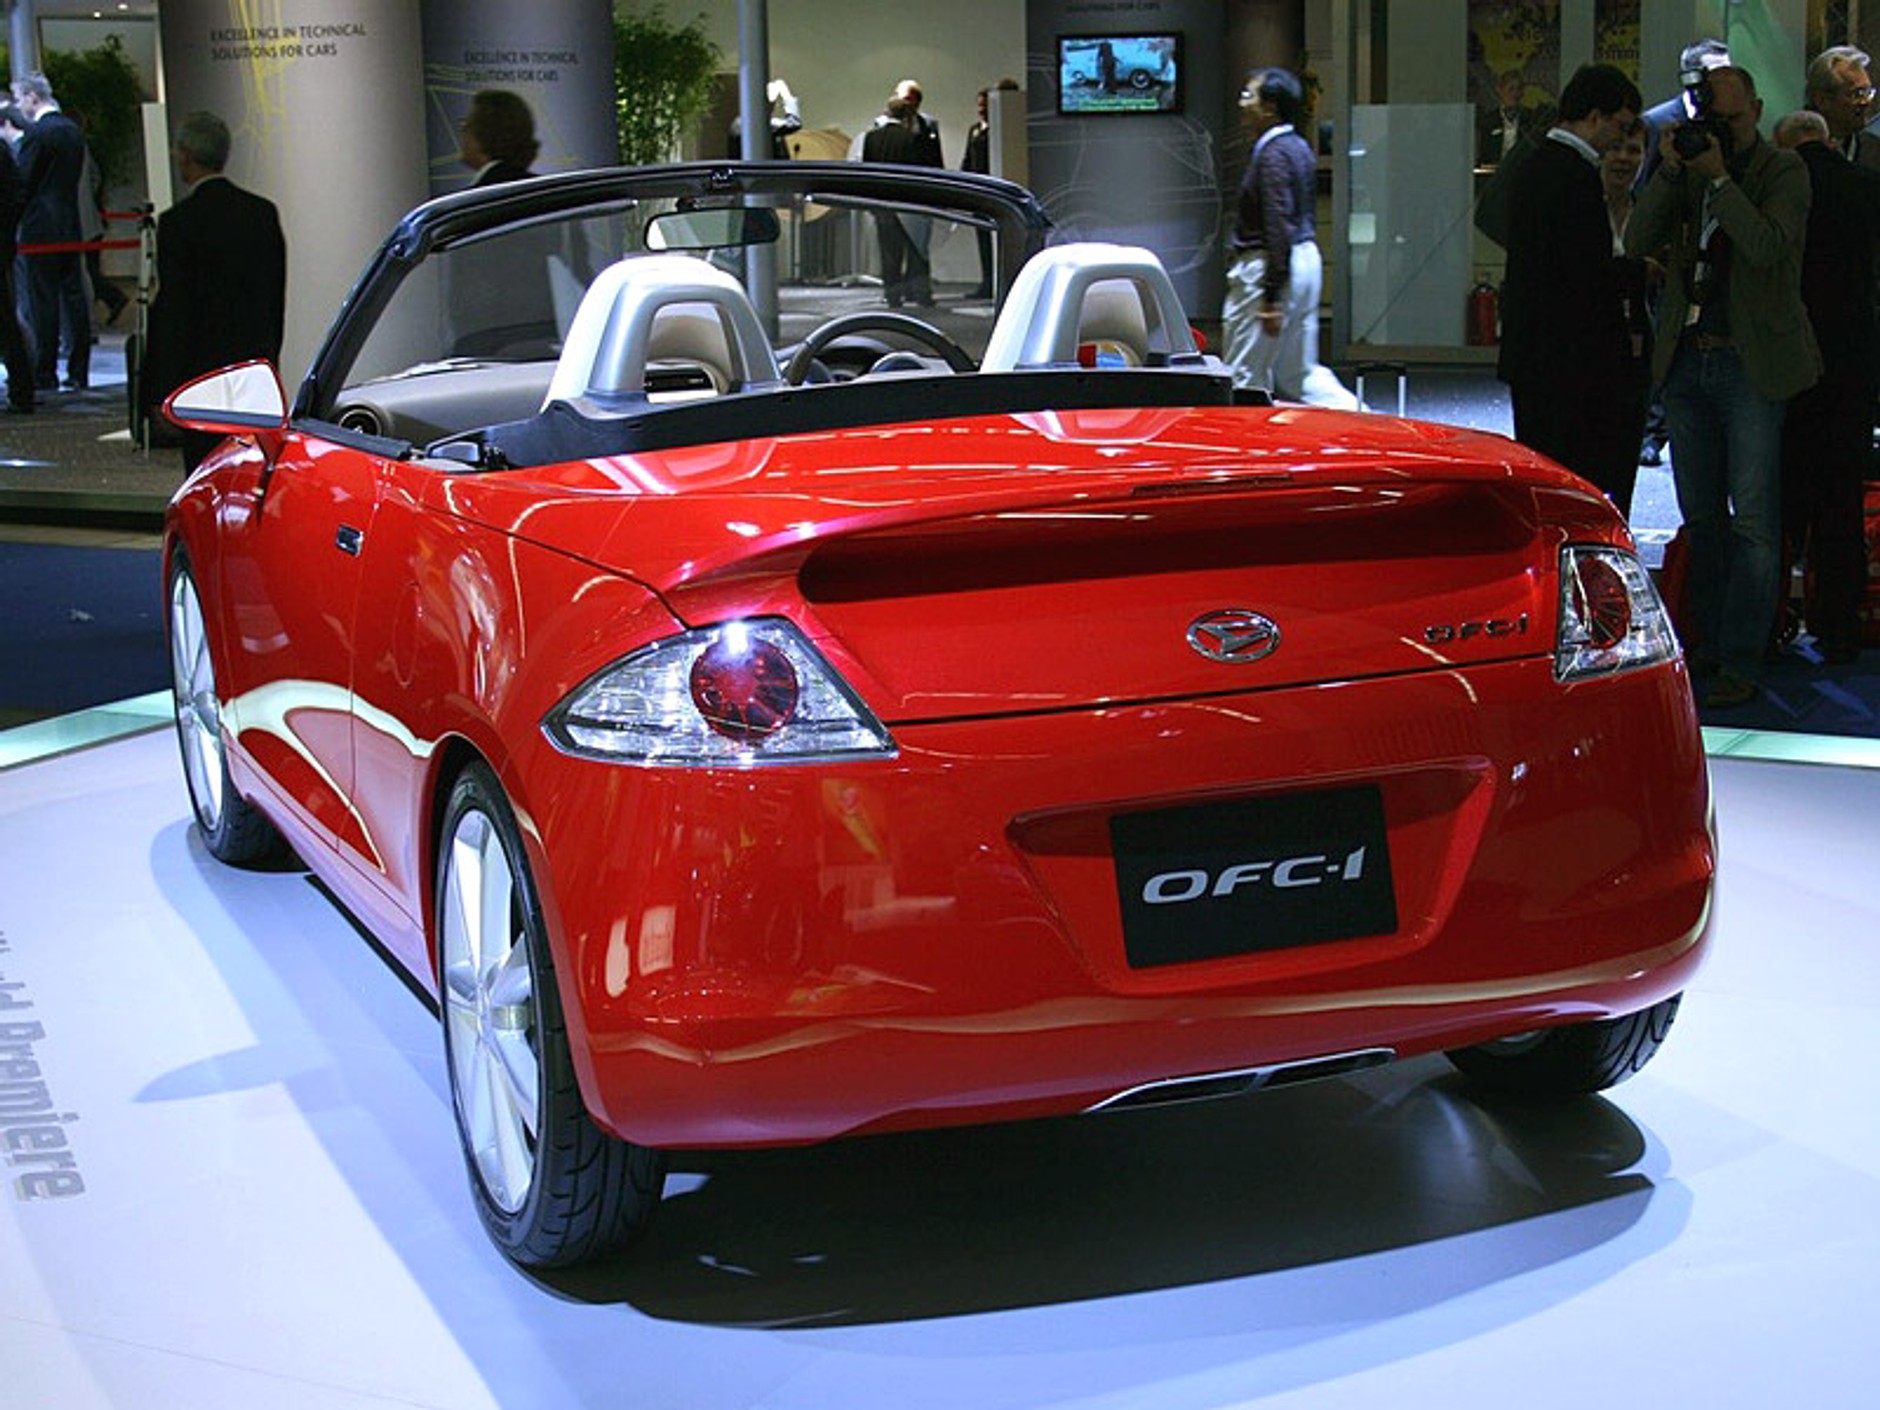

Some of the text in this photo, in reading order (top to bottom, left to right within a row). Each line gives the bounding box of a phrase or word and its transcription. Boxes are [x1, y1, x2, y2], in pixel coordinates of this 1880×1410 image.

[210, 23, 367, 42] EXCELLENCE IN TECHNICAL
[210, 43, 338, 60] SOLUTIONS FOR CARS
[464, 50, 579, 64] EXCELLENCE IN TECHNICAL
[465, 69, 559, 82] SOLUTIONS FOR CARS
